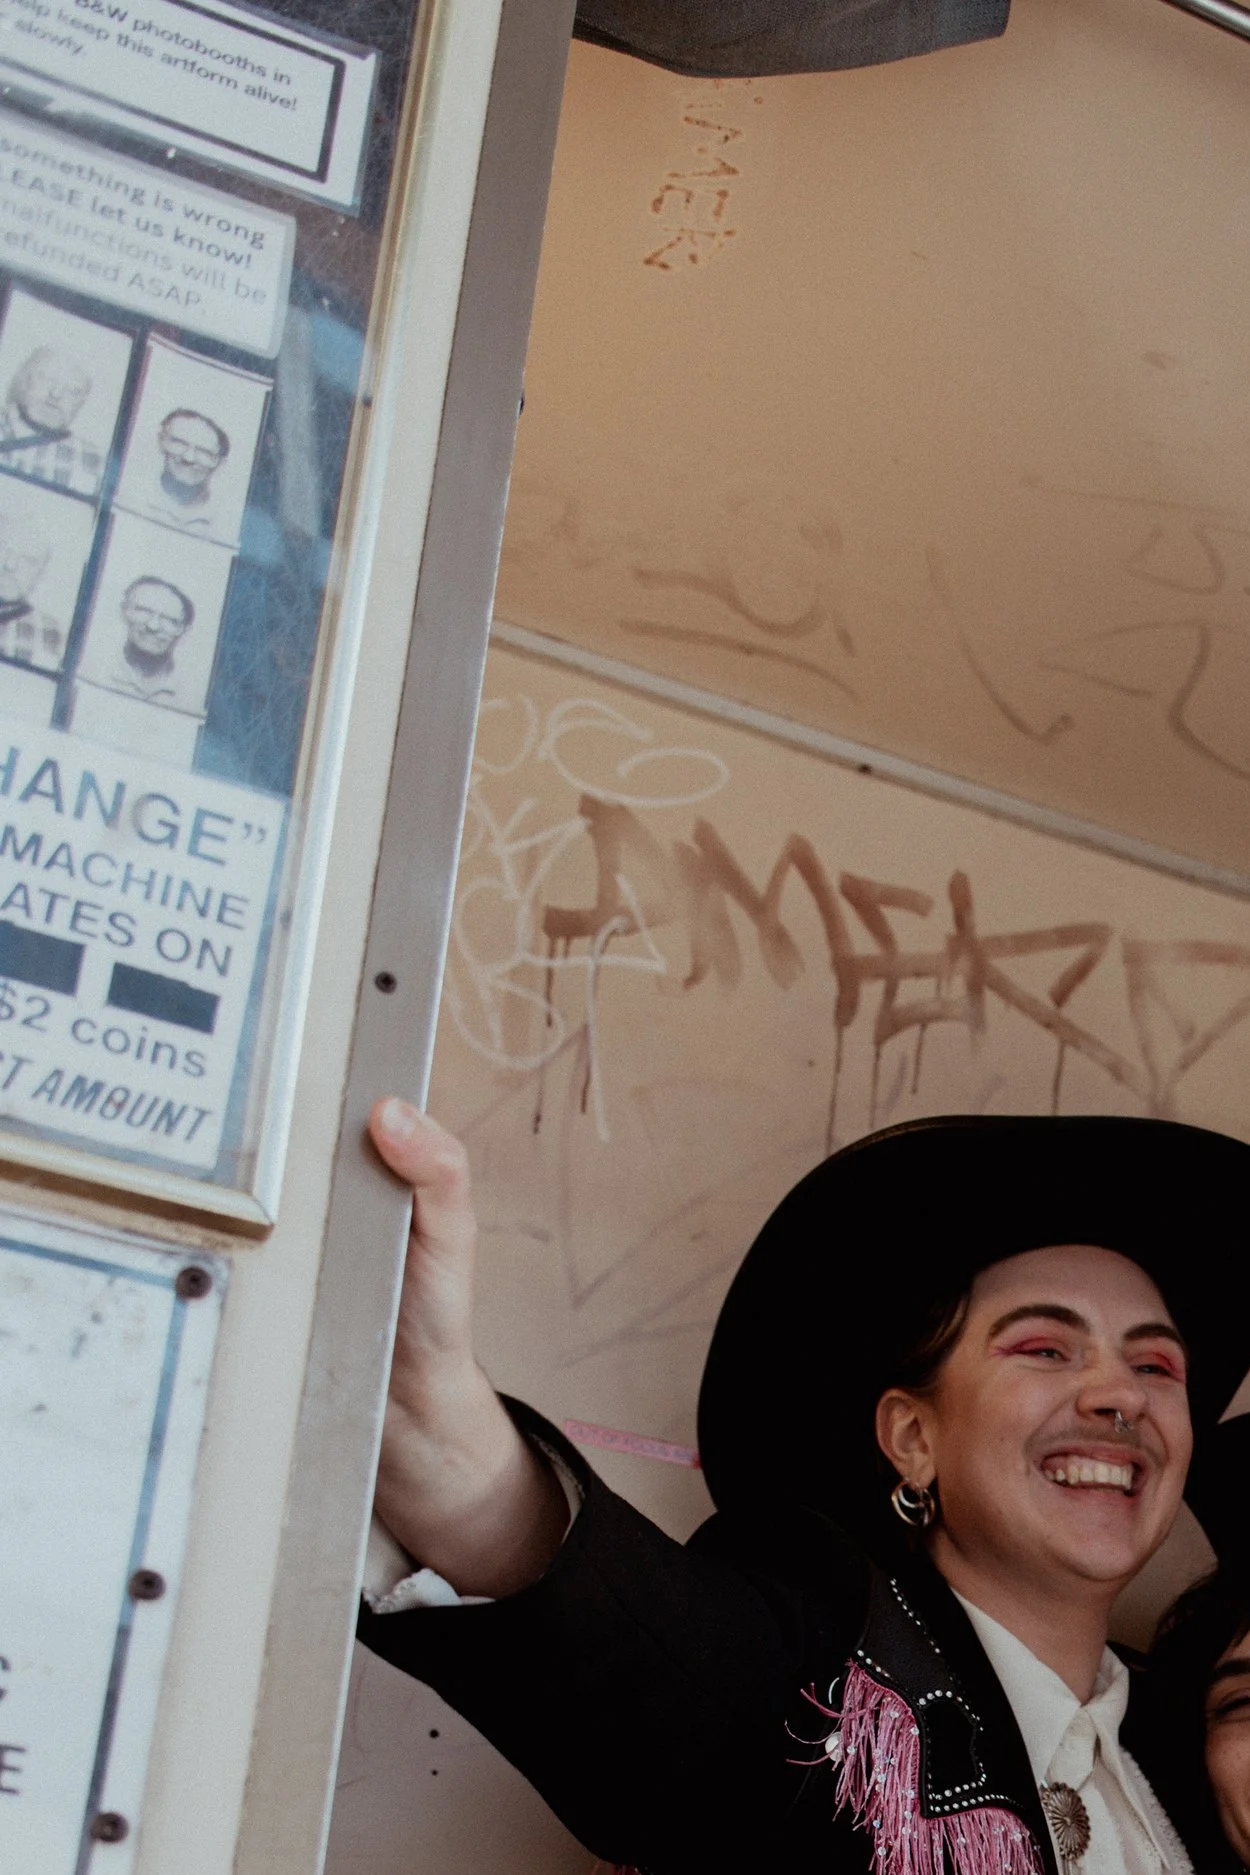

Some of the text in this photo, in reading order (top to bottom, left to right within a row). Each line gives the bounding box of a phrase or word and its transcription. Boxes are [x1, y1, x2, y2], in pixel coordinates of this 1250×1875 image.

[57, 7, 109, 41] keep
[117, 33, 155, 57] this
[160, 52, 239, 90] artform
[244, 83, 298, 111] alive!
[133, 19, 266, 77] photobooths
[272, 66, 291, 86] in
[90, 194, 126, 225] let
[135, 216, 164, 238] us
[173, 226, 252, 269] know!
[154, 190, 174, 213] is
[182, 205, 265, 250] wrong
[2, 230, 119, 283] efunded
[181, 262, 226, 290] will
[235, 277, 267, 304] be
[0, 823, 249, 932] MACHINE
[155, 926, 234, 979] ON
[71, 1016, 207, 1079] coins
[31, 1066, 214, 1144] AMOUNT
